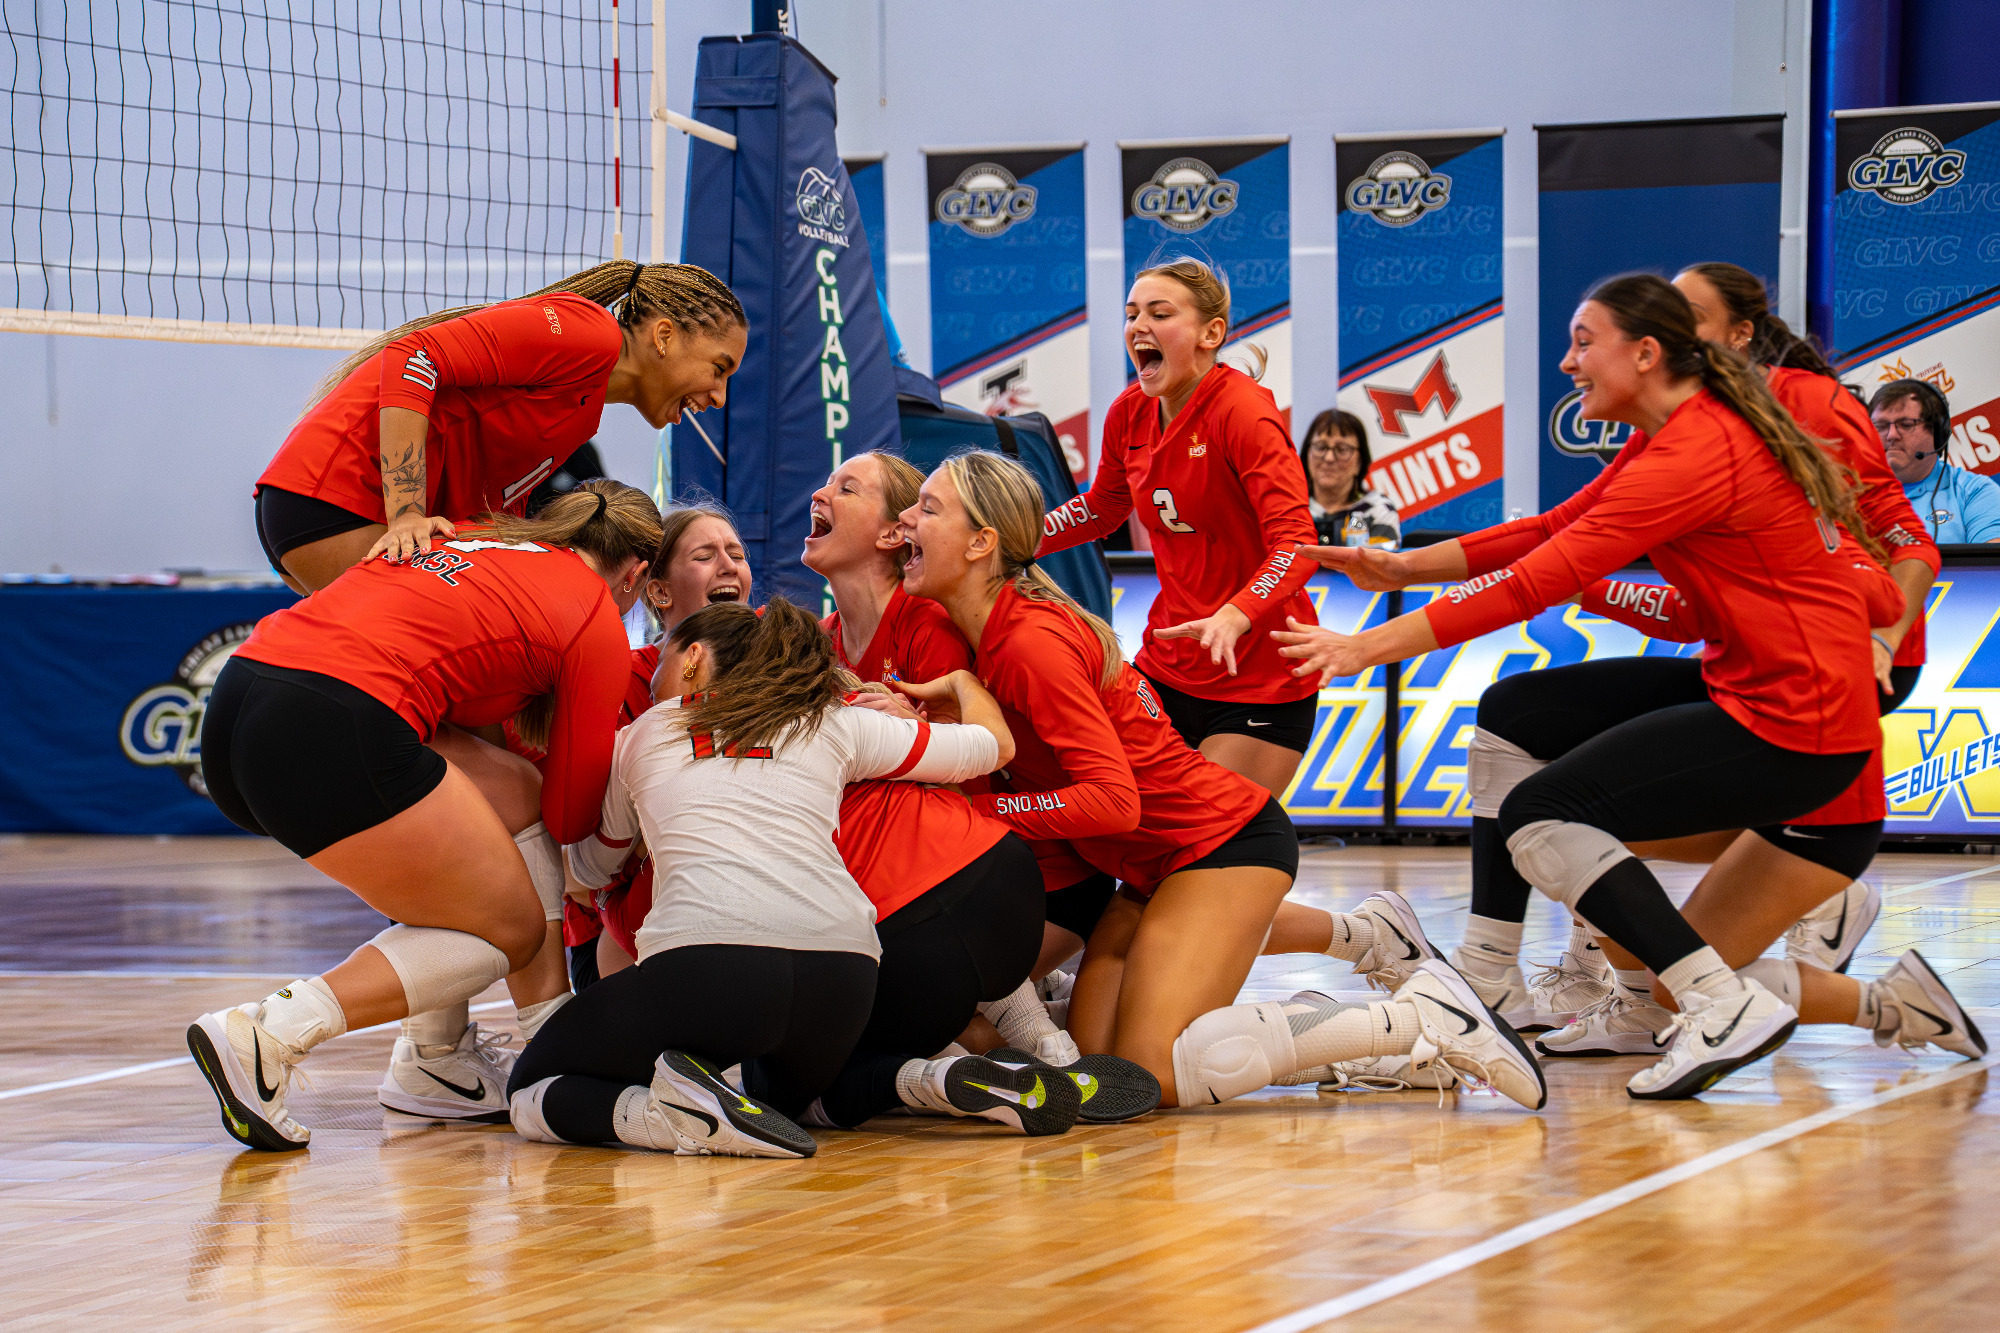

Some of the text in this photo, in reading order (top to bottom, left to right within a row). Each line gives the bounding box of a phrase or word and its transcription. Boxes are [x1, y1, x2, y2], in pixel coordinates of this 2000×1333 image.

[1852, 153, 1963, 189] GLVC
[939, 187, 1034, 220] GLVC
[1136, 182, 1237, 216] GLVC
[1349, 177, 1450, 211] GLVC
[798, 222, 850, 248] VOLLEYBALL
[1855, 235, 1962, 268] GLVC
[1362, 432, 1482, 513] AINTS
[1044, 494, 1099, 538] UMSL
[1152, 487, 1197, 534] 2
[1249, 550, 1296, 600] TRITONS
[1604, 579, 1671, 623] UMSL
[1909, 733, 2000, 801] BULLETS
[996, 792, 1067, 816] TRIONS
